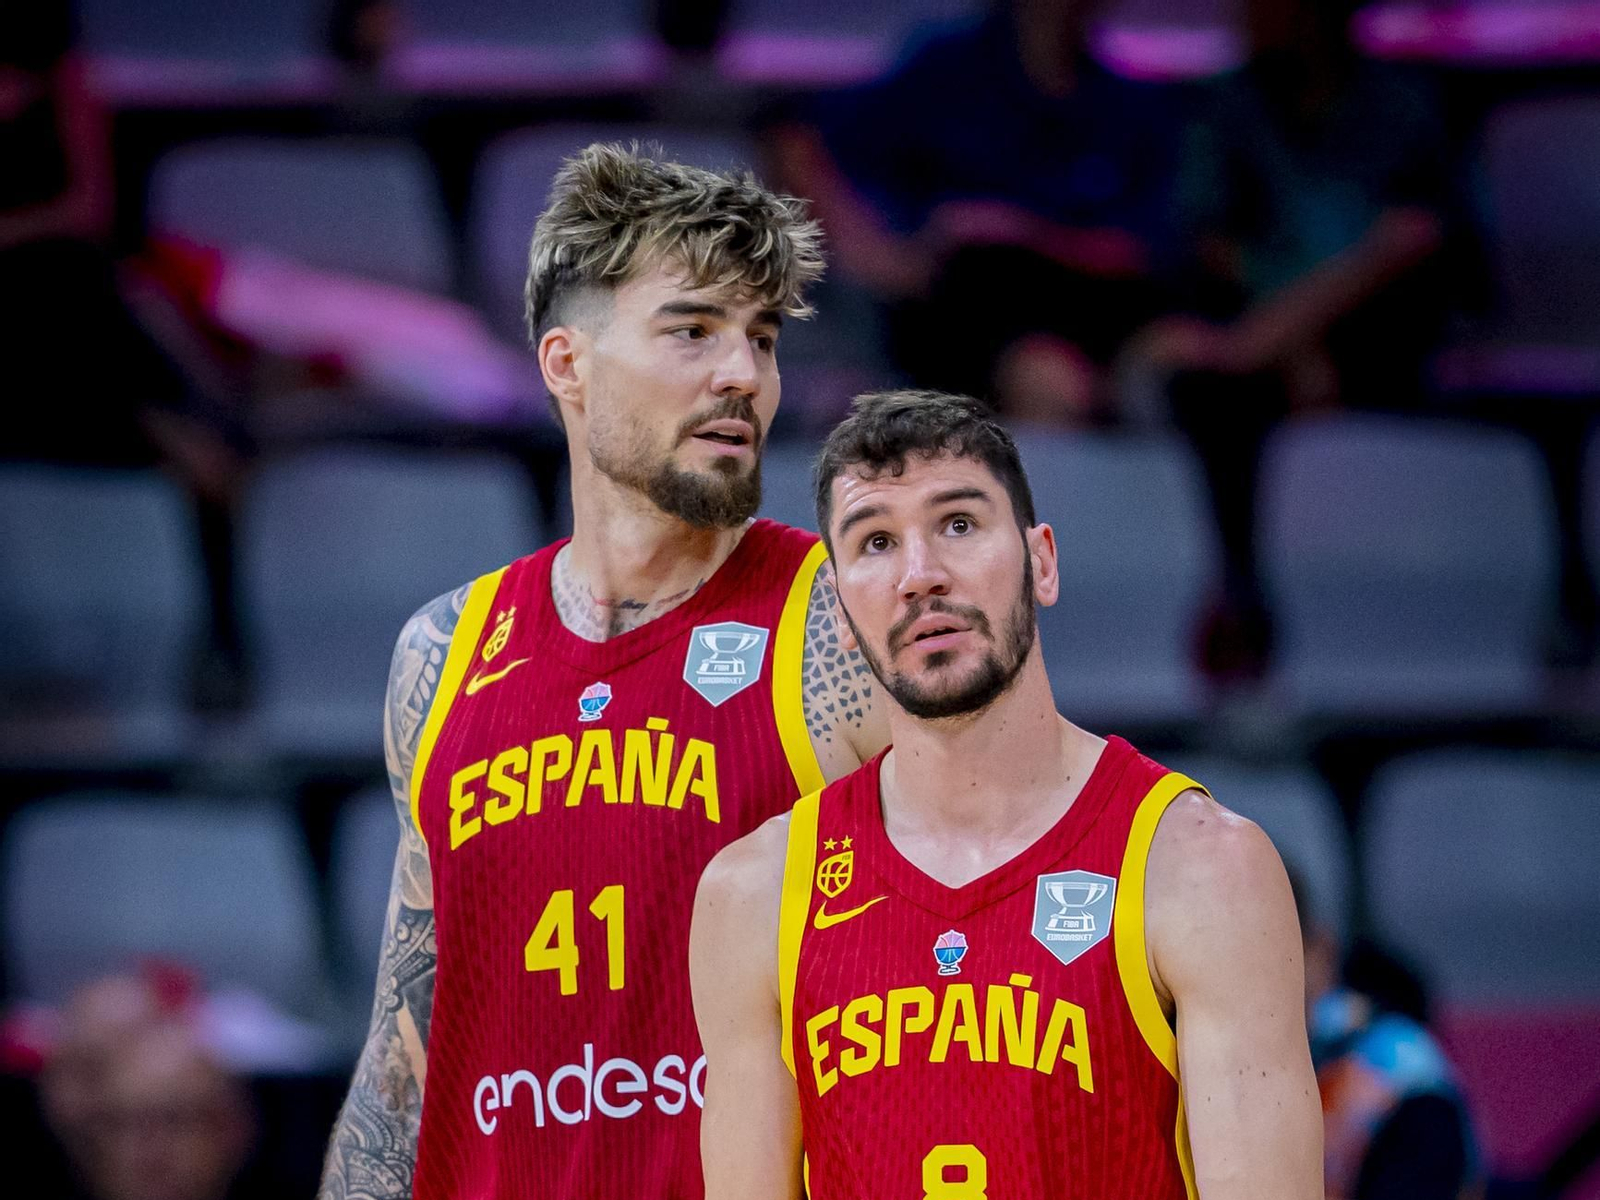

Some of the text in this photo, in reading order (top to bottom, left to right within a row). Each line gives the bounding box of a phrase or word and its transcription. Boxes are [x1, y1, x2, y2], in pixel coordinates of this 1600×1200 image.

[448, 716, 721, 851] ESPAÑA
[524, 884, 625, 996] 41
[805, 972, 1094, 1098] ESPAÑA
